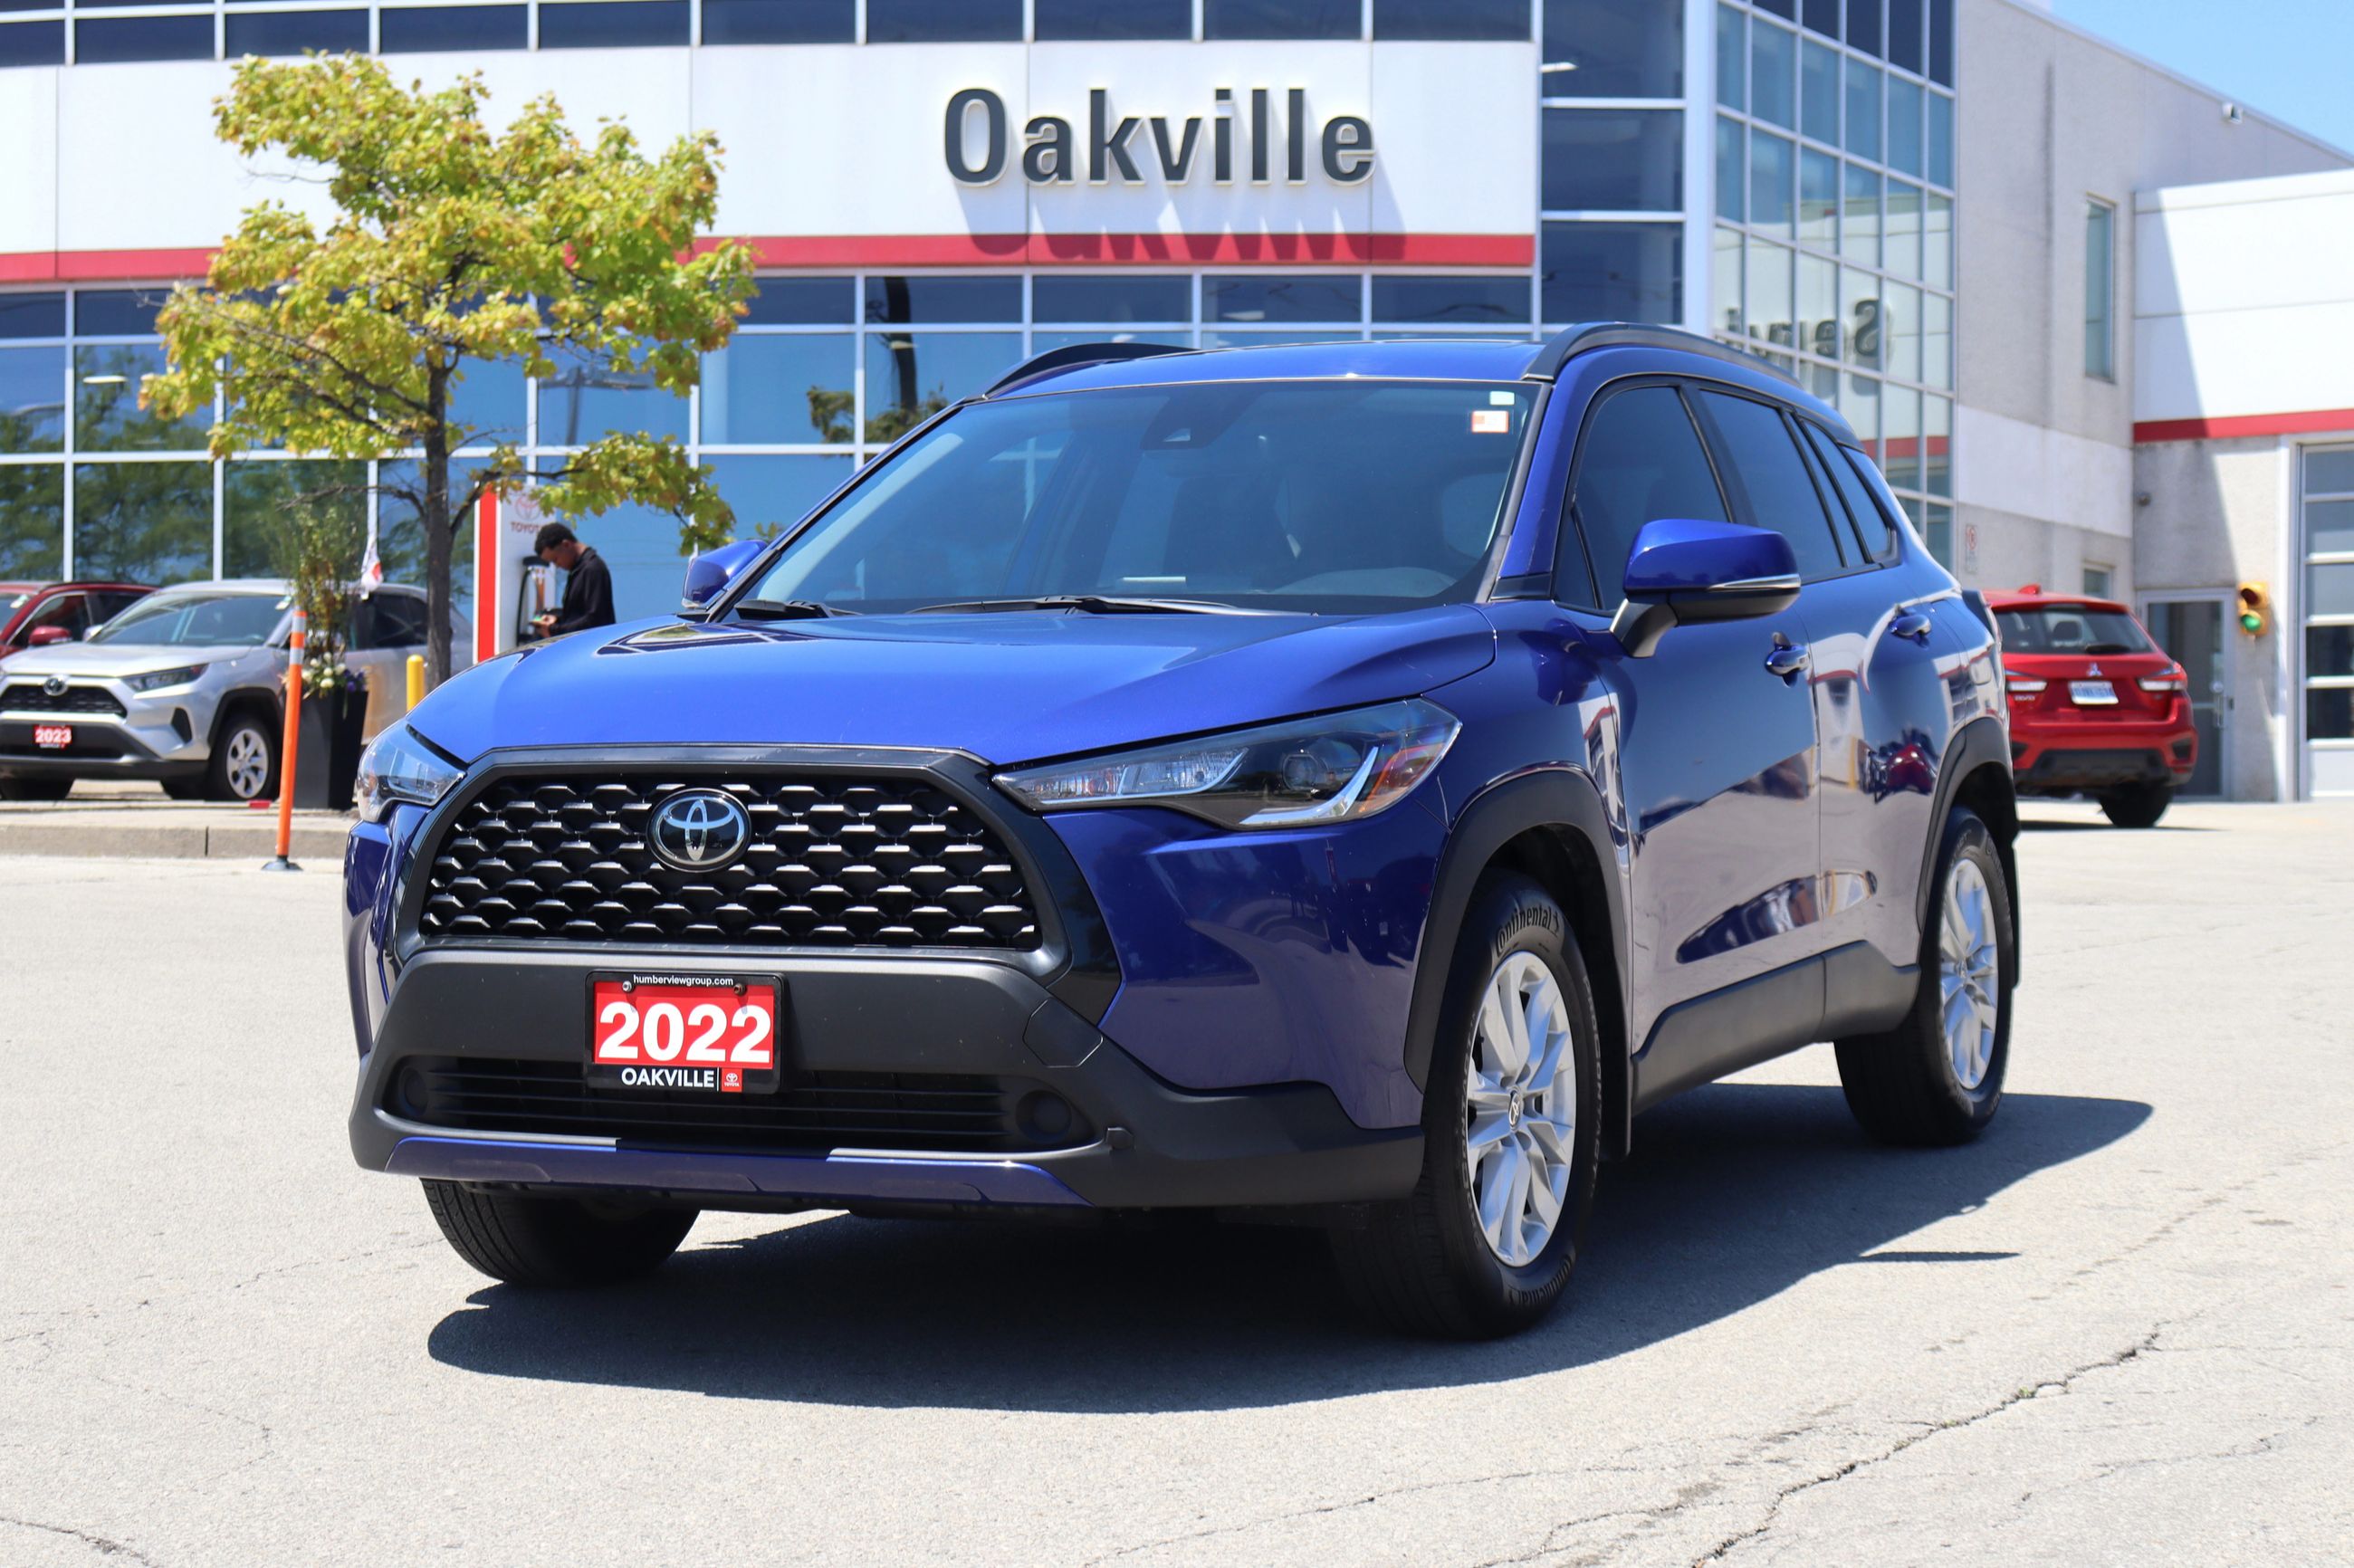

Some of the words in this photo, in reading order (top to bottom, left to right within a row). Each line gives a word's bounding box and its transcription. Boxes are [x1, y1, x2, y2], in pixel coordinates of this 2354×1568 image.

[943, 87, 1375, 186] Oakville
[511, 521, 541, 533] TOYOT
[35, 727, 72, 743] 2023
[1496, 905, 1552, 958] Continental
[634, 974, 733, 987] humberviewgroup.com
[598, 1001, 770, 1063] 2022
[621, 1067, 714, 1087] OAKVILLE
